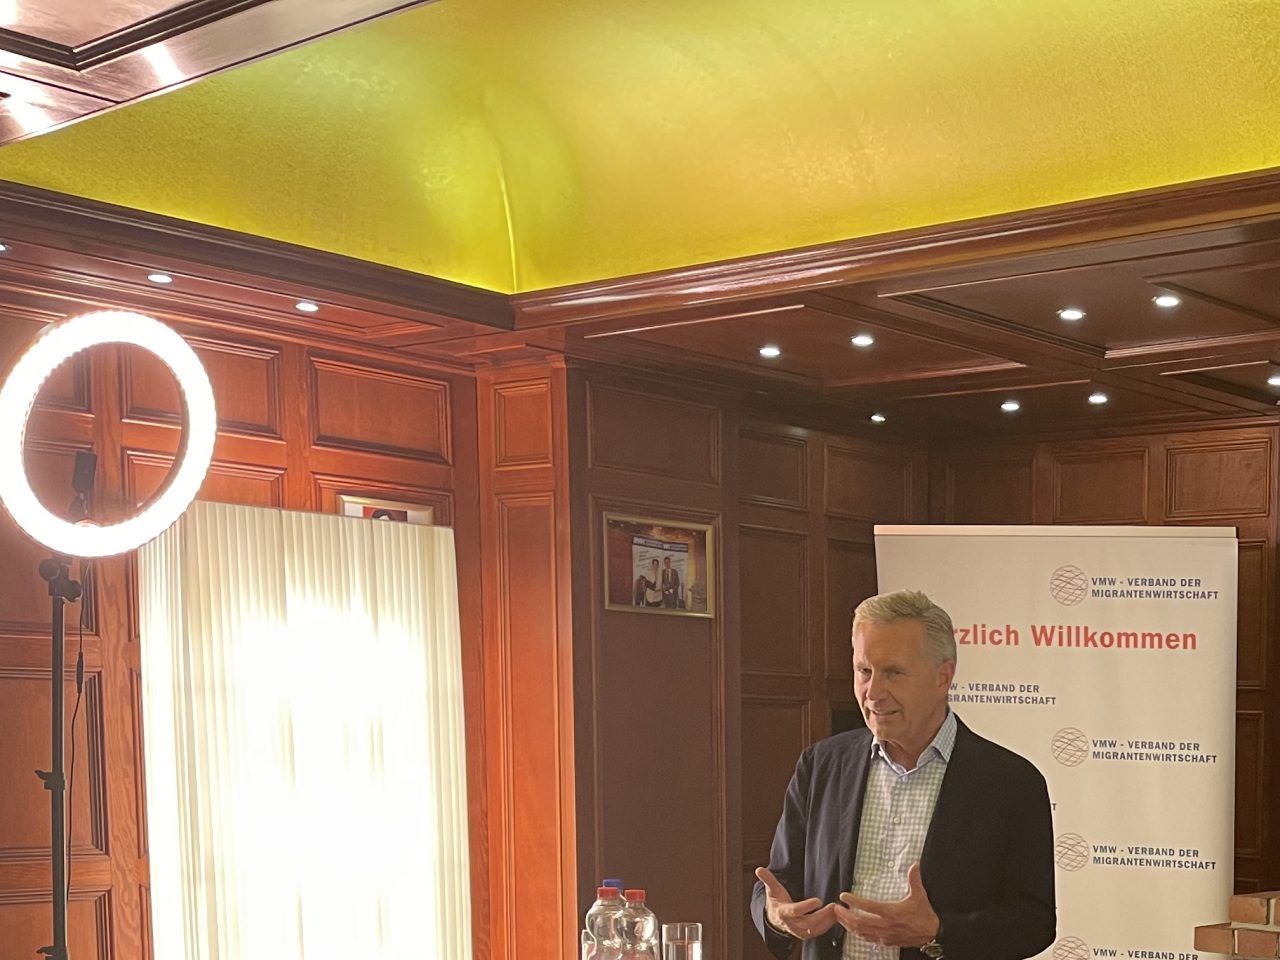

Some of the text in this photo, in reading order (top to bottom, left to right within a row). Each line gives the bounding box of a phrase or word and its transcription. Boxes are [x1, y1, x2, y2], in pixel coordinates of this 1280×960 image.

[1091, 577, 1117, 586] VMW
[1127, 577, 1177, 587] VERBAND
[1180, 578, 1201, 587] DER
[1091, 589, 1219, 600] MIGRANTENWIRTSCHAFT
[954, 623, 1197, 650] zlich Willkommen
[968, 682, 1016, 693] VERBAND
[1019, 684, 1040, 693] DER
[947, 694, 1057, 705] GRANTENWIRTSCHAFT
[1092, 739, 1117, 748] VMW
[1127, 740, 1176, 751] VERBAND
[1179, 742, 1200, 751] DER
[1092, 751, 1218, 764] MIGRANTENWIRTSCHAFT
[1092, 845, 1117, 854] VMW
[1127, 846, 1175, 857] VERBAND
[1179, 849, 1199, 858] DER
[1093, 856, 1217, 870] MIGRANTENWIRTSCHAFT
[1093, 948, 1117, 957] VMW
[1127, 950, 1175, 960] VERBAND
